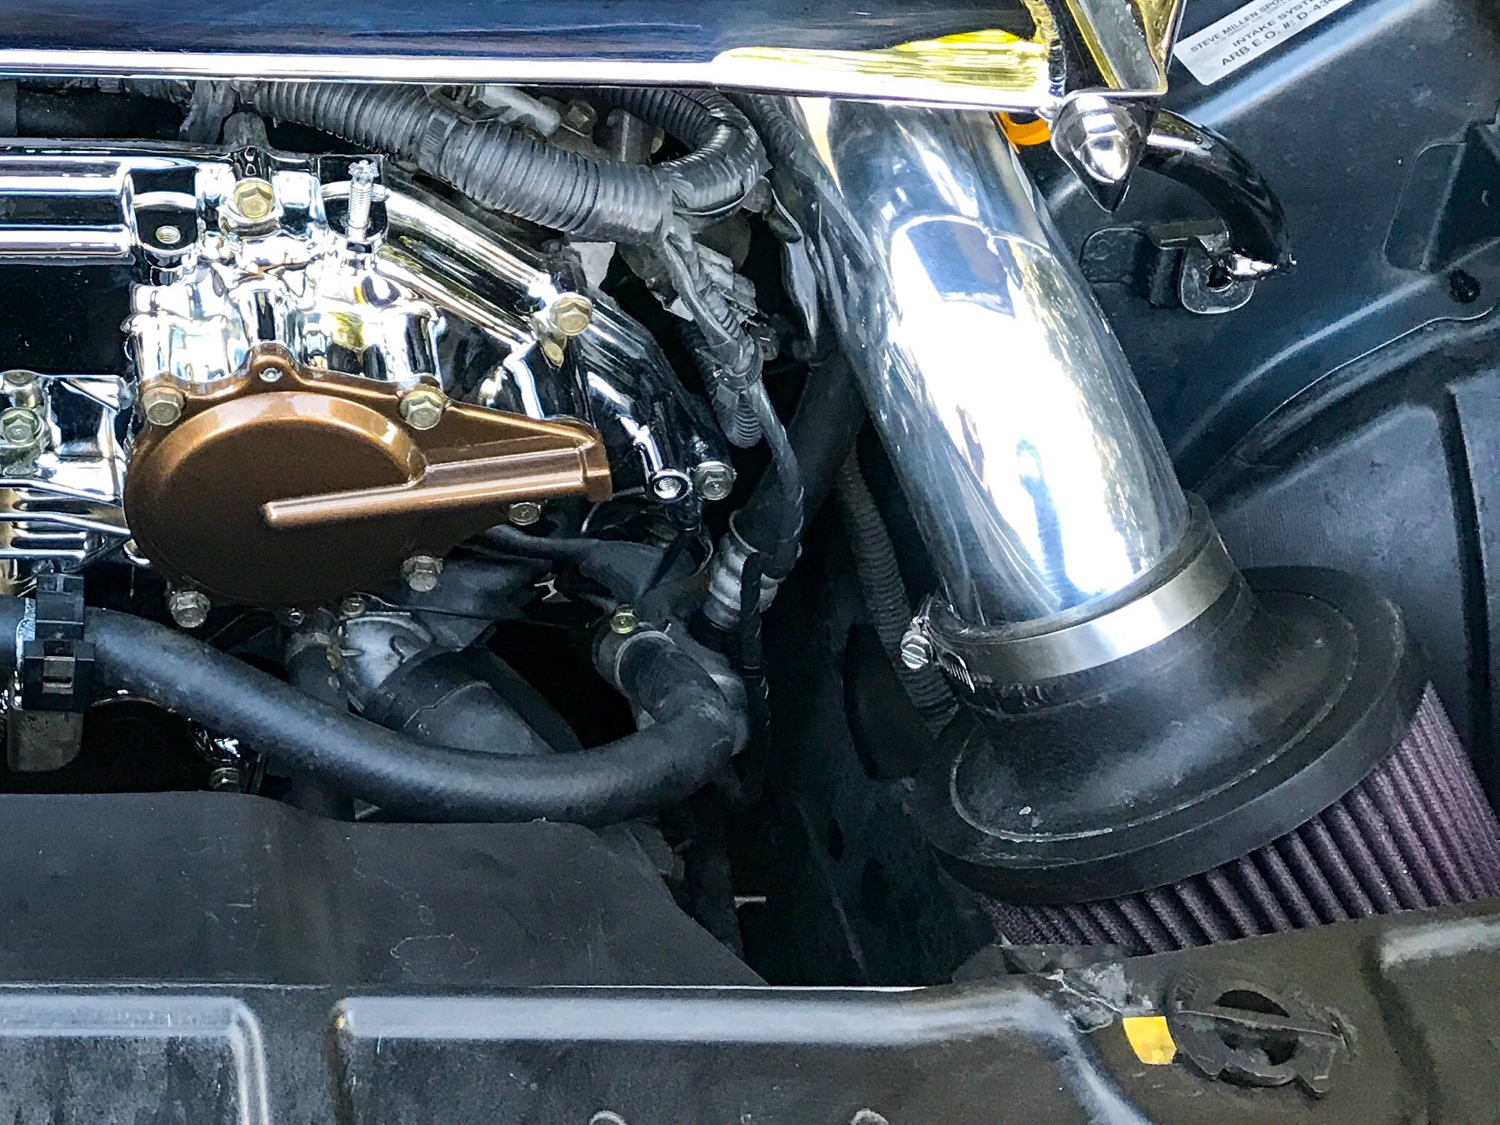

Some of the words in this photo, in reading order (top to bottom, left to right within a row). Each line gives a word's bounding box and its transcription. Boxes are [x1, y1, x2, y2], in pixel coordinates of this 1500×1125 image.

[1190, 33, 1222, 53] STEVE
[1222, 11, 1259, 35] MILLEN
[1232, 19, 1277, 47] INTAKE
[1220, 45, 1251, 66] ARB
